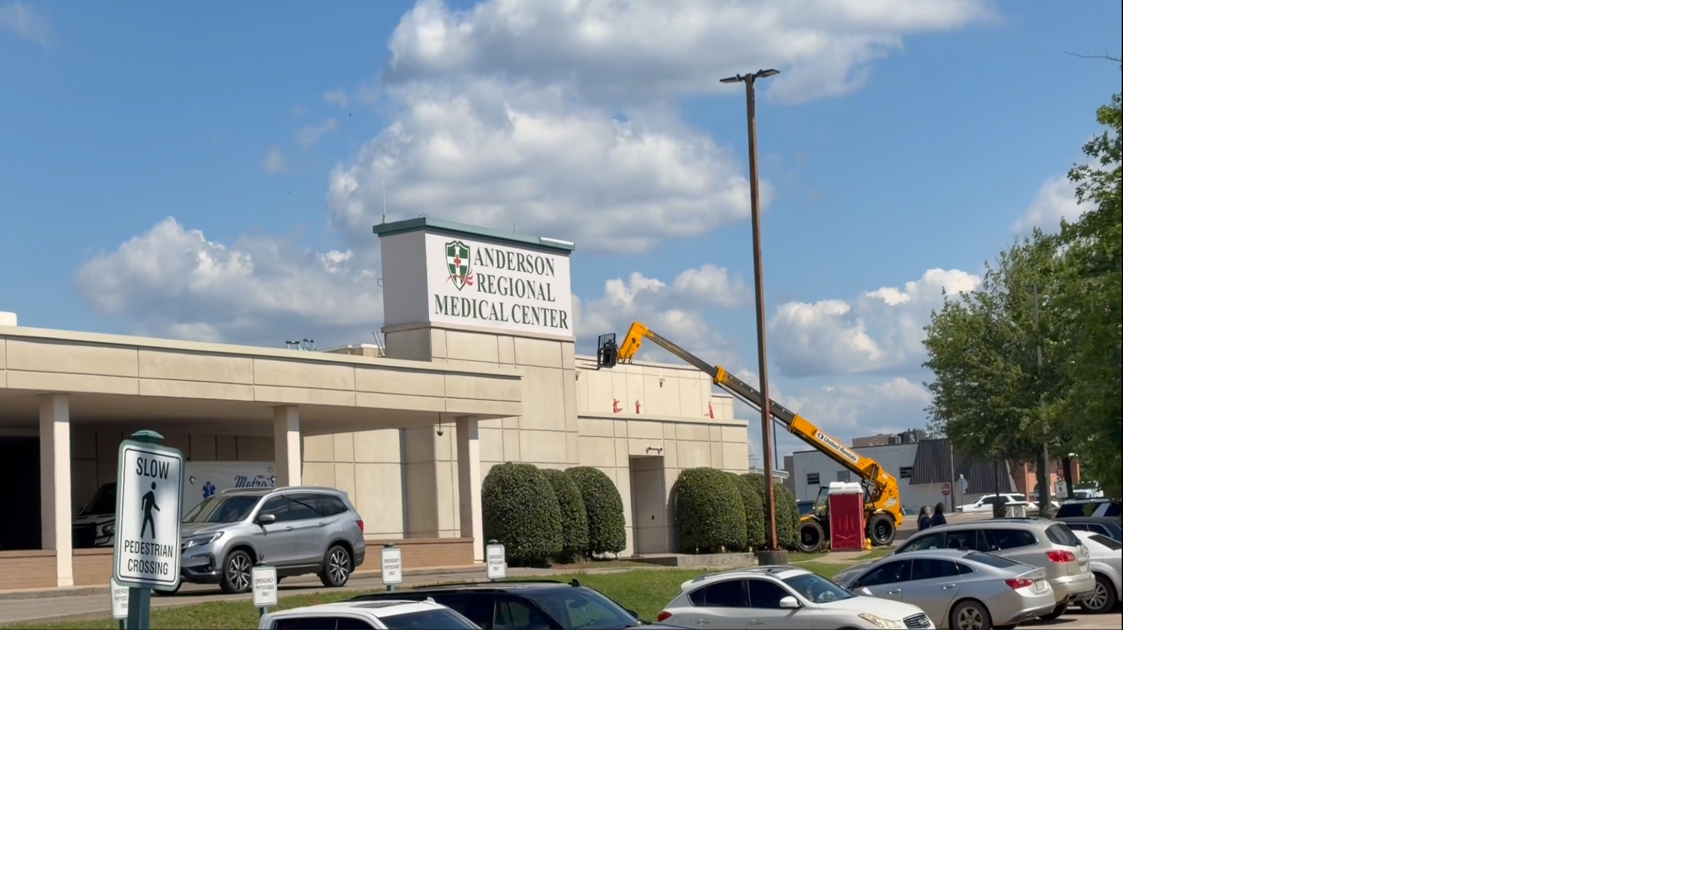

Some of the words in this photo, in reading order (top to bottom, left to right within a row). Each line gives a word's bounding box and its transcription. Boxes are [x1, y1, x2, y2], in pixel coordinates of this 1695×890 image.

[473, 246, 555, 277] ANDERSON
[476, 272, 556, 302] REGIONAL
[434, 294, 509, 322] MEDICAL
[511, 303, 569, 330] CENTER
[823, 435, 840, 450] United
[839, 446, 857, 462] Rentals
[136, 457, 170, 480] SLOW
[124, 539, 174, 558] PEDESTRIAN
[127, 558, 169, 575] CROSSING
